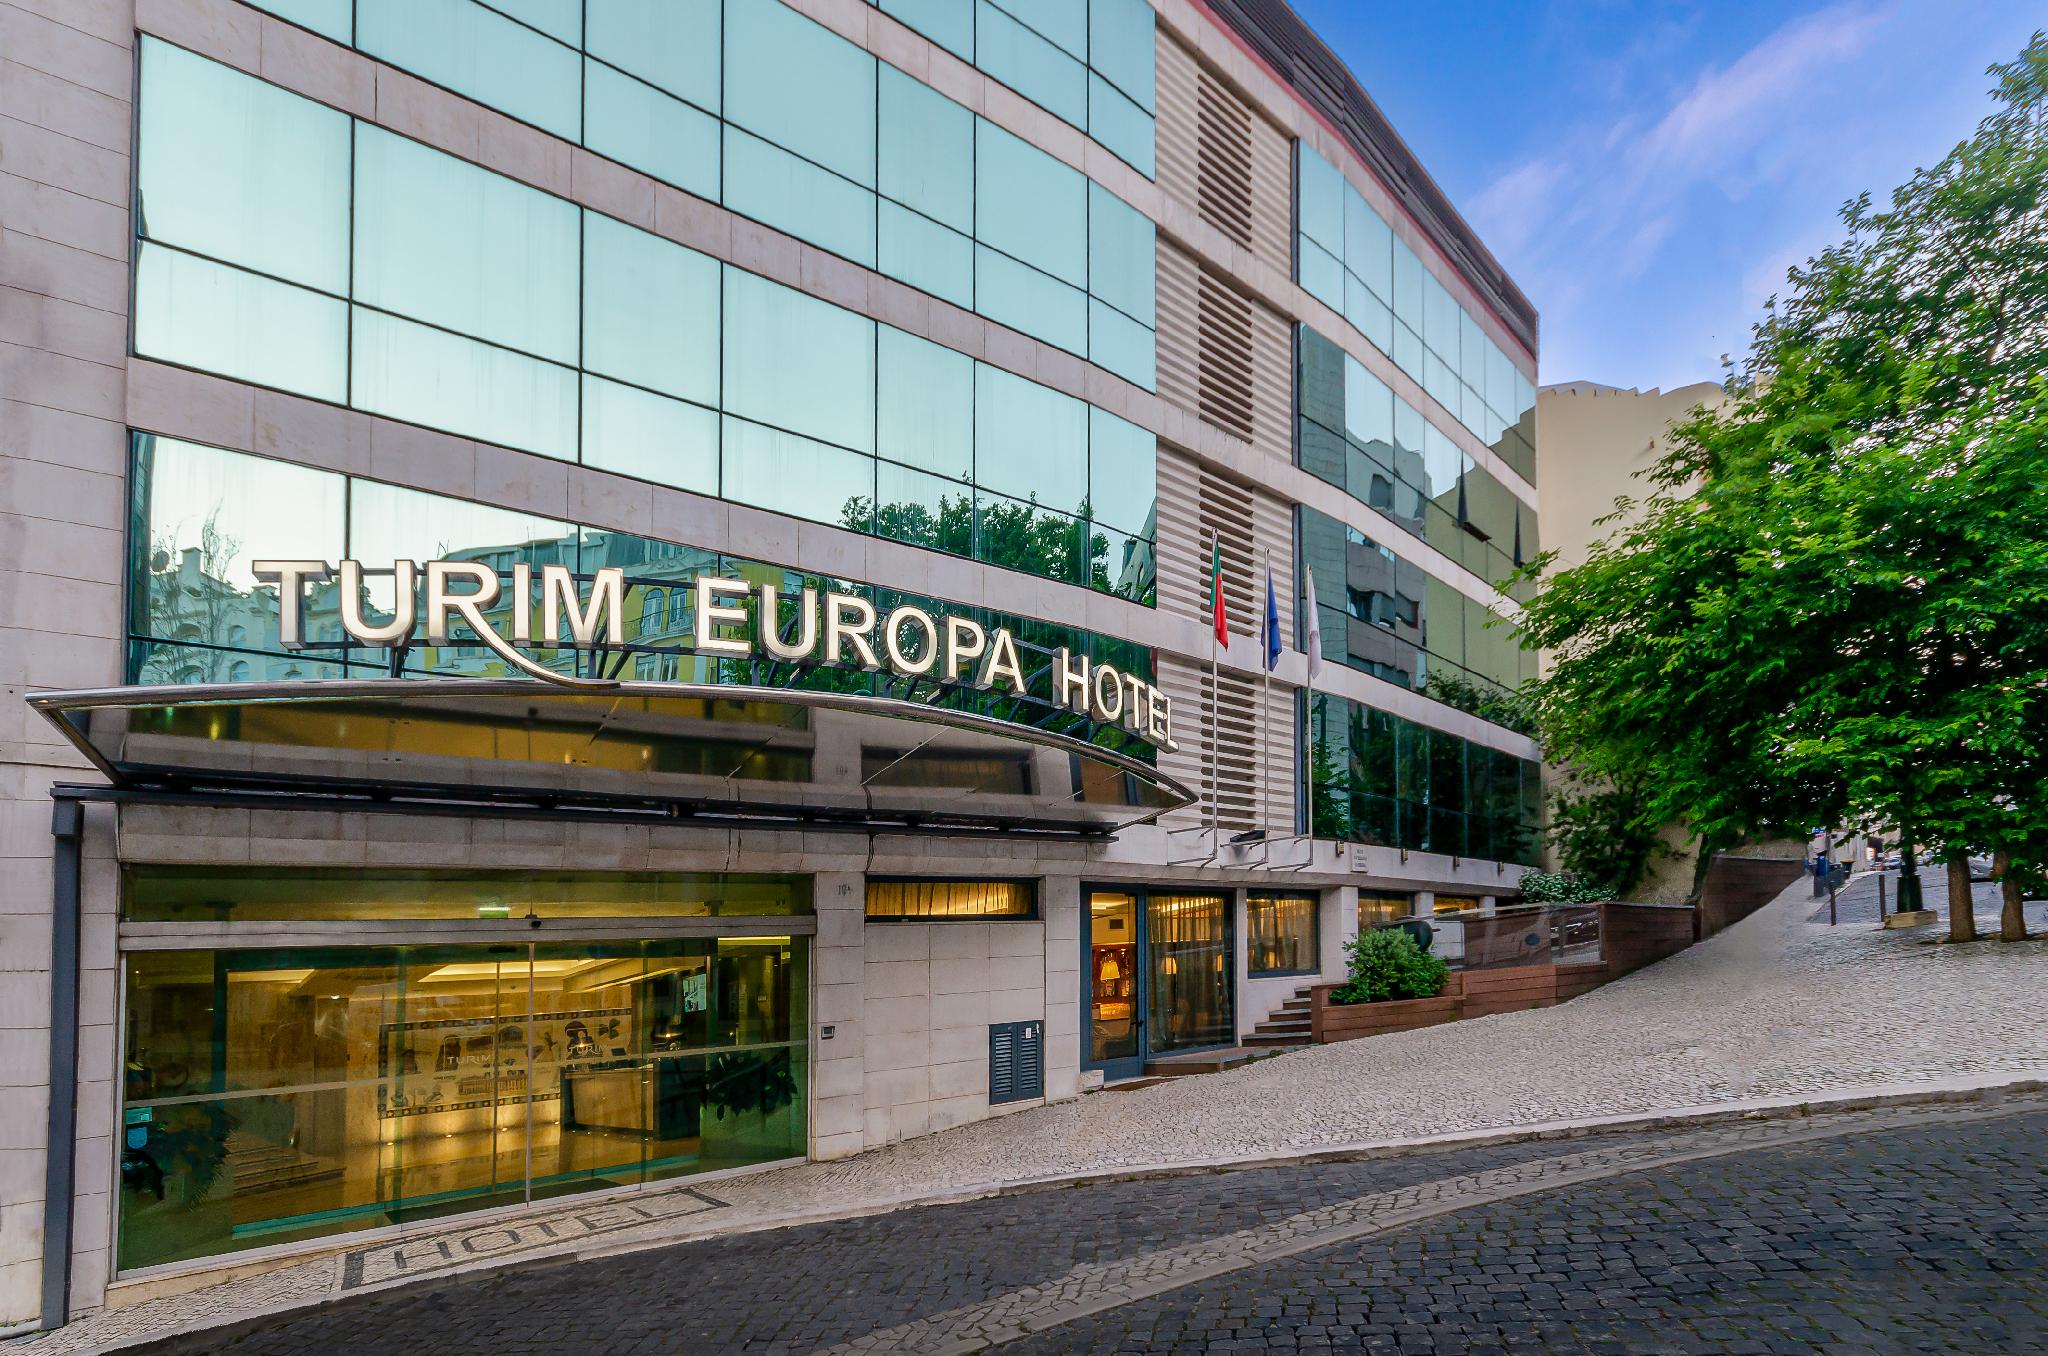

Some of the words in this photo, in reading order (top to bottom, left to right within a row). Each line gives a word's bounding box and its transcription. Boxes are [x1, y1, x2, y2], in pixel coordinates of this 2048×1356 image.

[252, 559, 621, 689] TURIM
[695, 576, 1027, 697] EUROPA
[1053, 646, 1179, 753] HOTEL
[447, 1054, 491, 1065] TURIM
[394, 1206, 687, 1270] HOTEL
